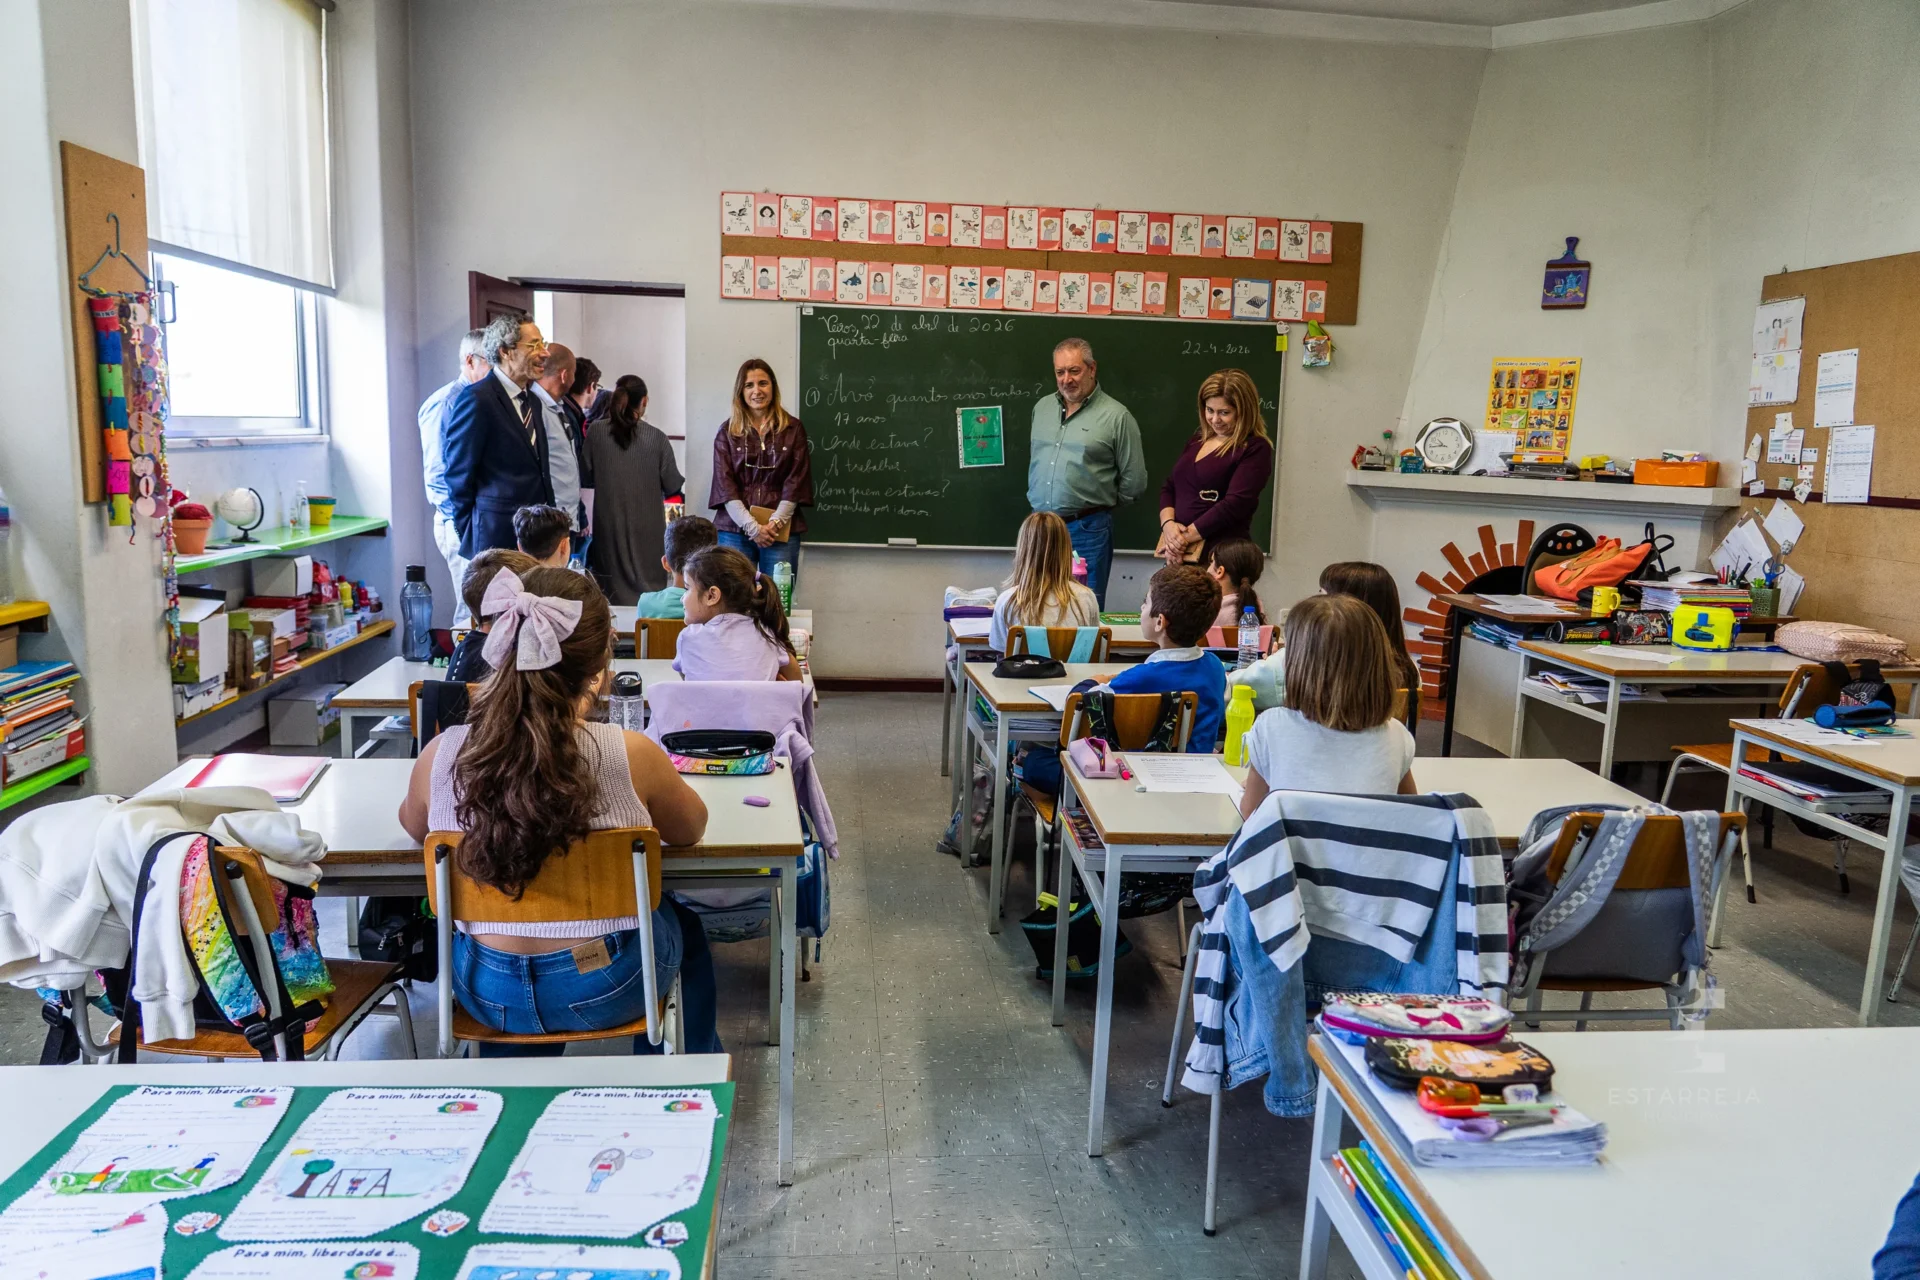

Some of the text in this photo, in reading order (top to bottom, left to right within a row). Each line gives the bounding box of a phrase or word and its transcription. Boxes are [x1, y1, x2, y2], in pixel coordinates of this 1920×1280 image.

[862, 314, 880, 330] 22
[891, 314, 902, 331] de
[912, 314, 940, 330] abril
[948, 316, 958, 332] de
[969, 318, 1016, 332] 2026
[828, 332, 908, 360] quarta-feira
[886, 386, 948, 412] quantos
[834, 412, 886, 426] 17 anos
[849, 486, 880, 504] quem
[576, 952, 598, 964] DENIM
[142, 1088, 172, 1096] Para
[234, 1249, 269, 1258] Para
[274, 1248, 306, 1258] mim,
[312, 1248, 382, 1257] liberdade
